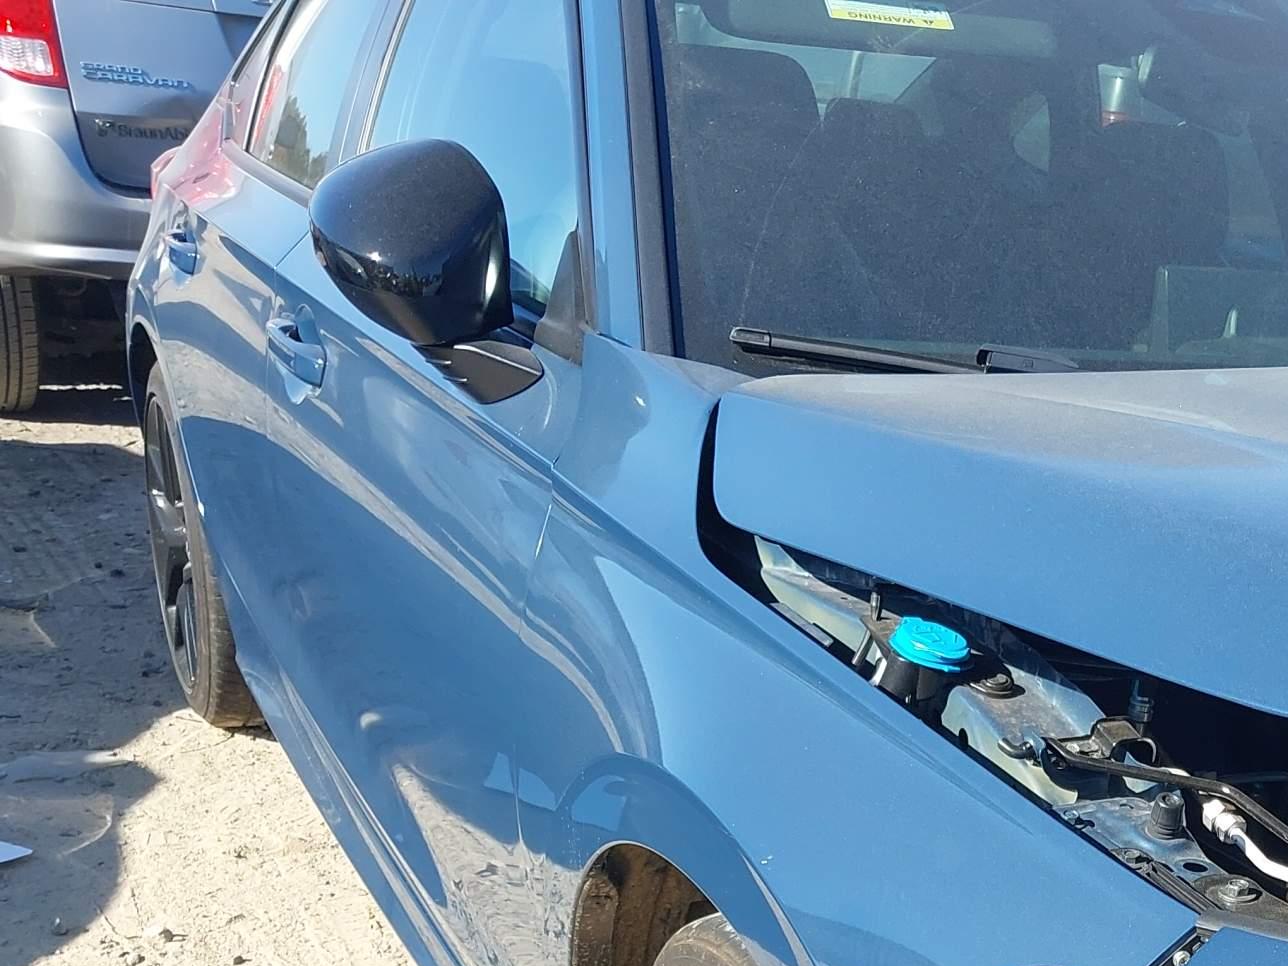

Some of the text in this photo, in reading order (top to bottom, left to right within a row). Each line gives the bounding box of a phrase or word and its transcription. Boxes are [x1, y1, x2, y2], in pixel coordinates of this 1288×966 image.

[848, 12, 915, 24] WARNING
[80, 62, 143, 75] GRAND
[80, 69, 190, 88] CARAVAN
